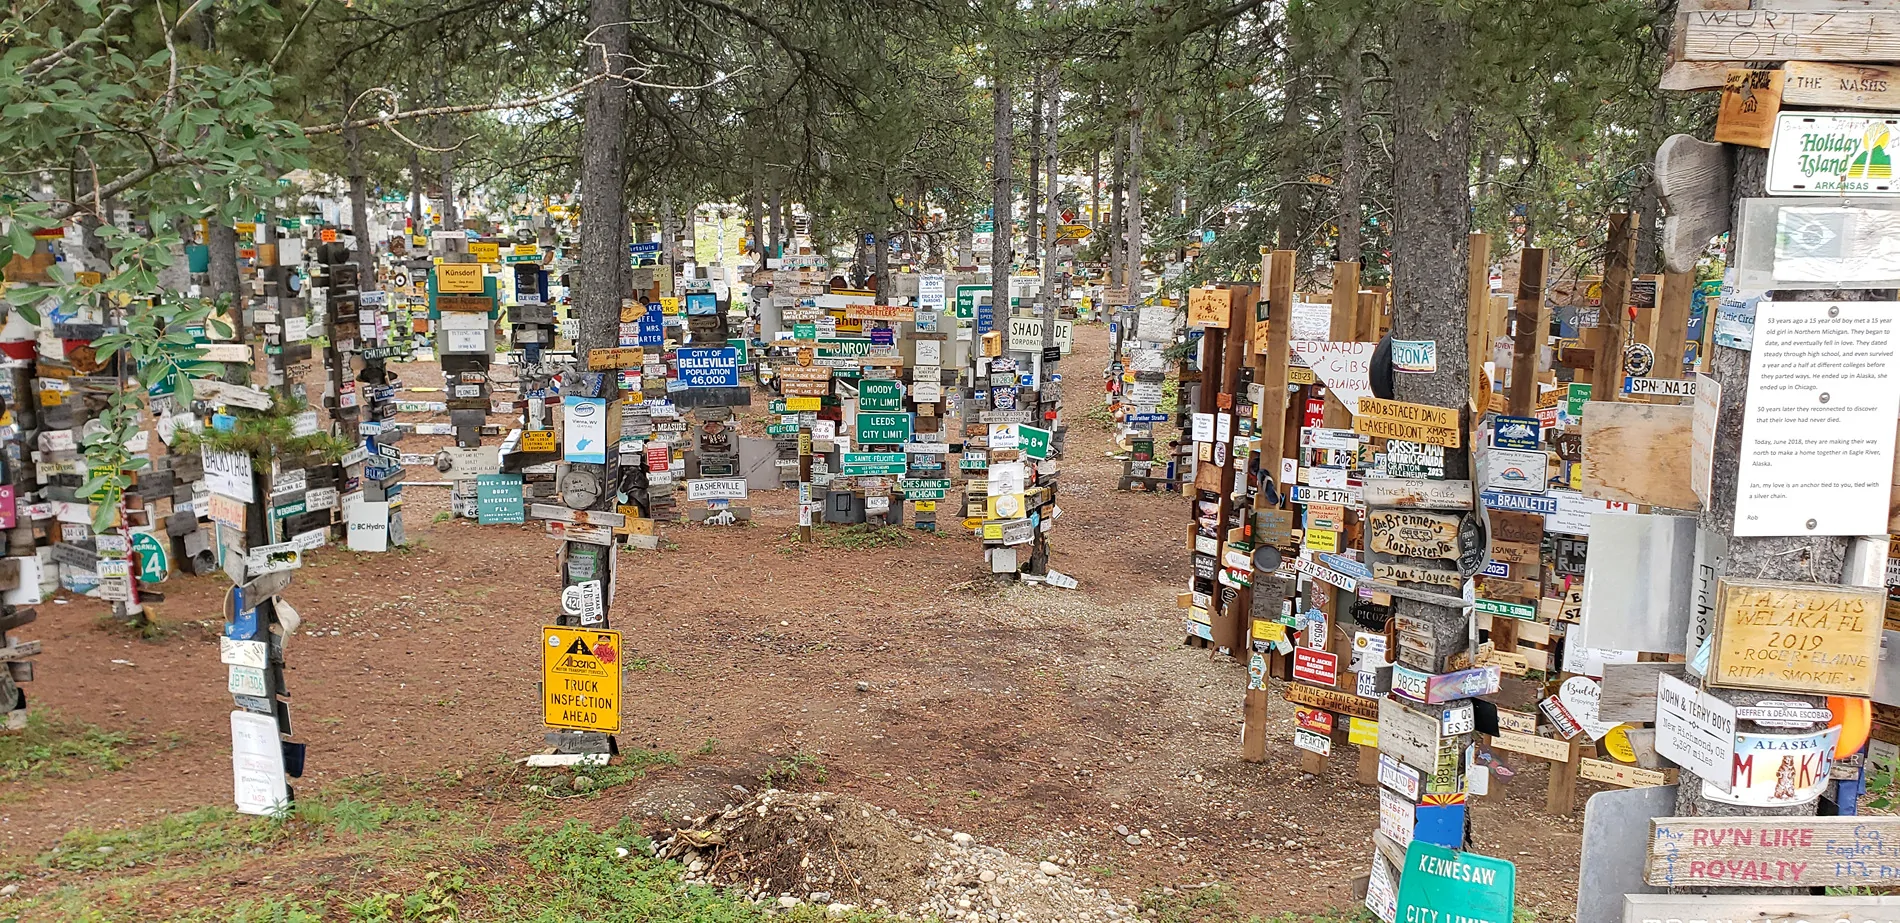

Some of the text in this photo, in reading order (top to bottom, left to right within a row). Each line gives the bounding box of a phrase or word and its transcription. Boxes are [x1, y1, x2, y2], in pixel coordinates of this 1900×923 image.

[1797, 77, 1822, 89] THE
[1801, 133, 1862, 157] Holiday
[1800, 154, 1850, 178] Island
[1814, 181, 1869, 190] ARKANSAS
[1011, 322, 1068, 338] SHADYDE
[1296, 341, 1364, 354] EDWARD
[1392, 347, 1429, 364] RIZONA
[679, 359, 735, 368] BELLEVILLE
[691, 376, 726, 385] 46,000
[866, 385, 893, 394] MOODY
[860, 398, 900, 407] CITY LIMIT
[1360, 399, 1381, 415] BRAD
[1388, 404, 1420, 420] STACEY
[1421, 409, 1447, 424] DAVIS
[870, 417, 896, 426] LEEDS
[862, 430, 903, 439] CITY LIMIT
[1426, 427, 1447, 437] XMAS
[1030, 437, 1037, 447] 8
[1387, 469, 1428, 480] VILLENEUVE
[1427, 467, 1444, 476] 2023
[694, 482, 740, 491] BASHERVILLE
[902, 480, 942, 488] CHESANING
[908, 490, 937, 498] MICHIGAN
[1317, 490, 1330, 500] PE
[1331, 491, 1350, 503] 17H
[1497, 495, 1555, 511] BRANLETTE
[365, 523, 386, 531] Hydro
[1385, 513, 1443, 533] Brenner's
[145, 552, 162, 577] 4
[1487, 565, 1505, 574] 2025
[1386, 566, 1451, 584] Dan Joyce
[1695, 563, 1714, 651] Erichsen
[1808, 597, 1866, 614] DAYS
[1836, 615, 1864, 633] FL
[1767, 632, 1824, 651] 2019
[561, 656, 596, 670] Alberta
[1743, 648, 1870, 668] ROGER ELAINE
[229, 672, 245, 686] JBT
[1727, 665, 1844, 685] RITA SMOKIE
[564, 678, 598, 693] TRUCK
[550, 693, 612, 710] INSPECTION
[562, 710, 597, 724] AHEAD
[1660, 687, 1731, 734] JOHN & TERRY BOYS
[1737, 709, 1766, 717] JEFFREY
[1773, 709, 1798, 718] DEANA
[1799, 710, 1829, 719] ESCOBAR
[1663, 717, 1676, 731] New
[1754, 739, 1818, 751] ALASKA
[1693, 749, 1714, 767] miles
[1692, 828, 1753, 847] RV'N
[1759, 828, 1815, 847] LIKE
[1418, 853, 1497, 886] KENNESAW
[1689, 860, 1809, 882] ROYALTY
[1406, 904, 1439, 923] CITY
